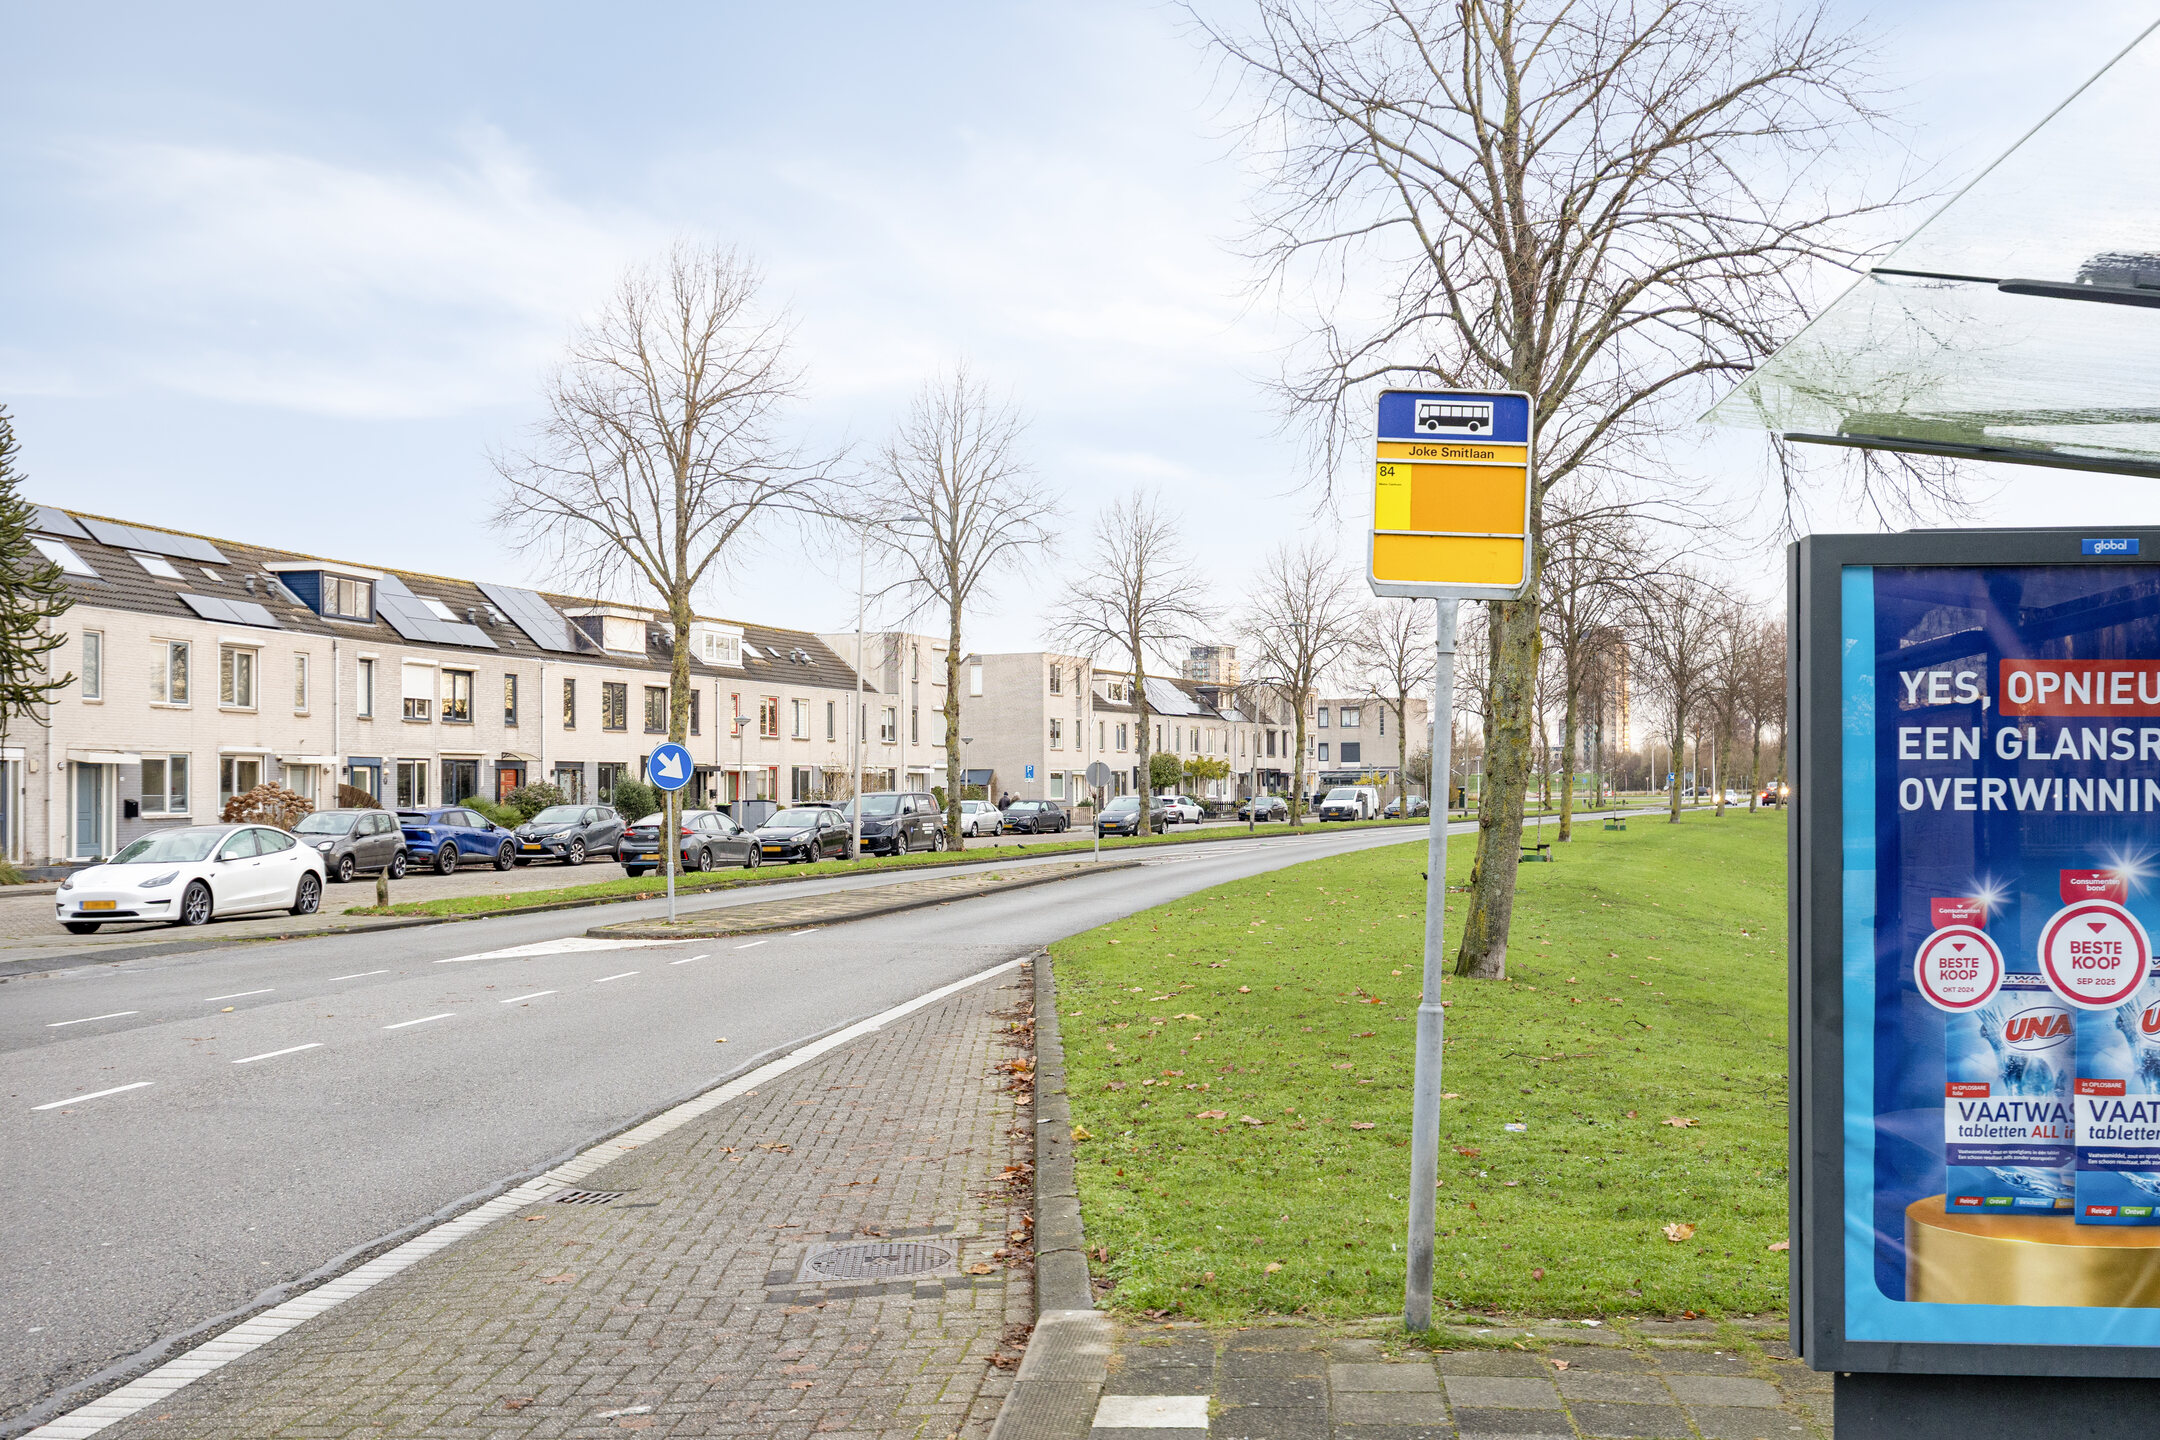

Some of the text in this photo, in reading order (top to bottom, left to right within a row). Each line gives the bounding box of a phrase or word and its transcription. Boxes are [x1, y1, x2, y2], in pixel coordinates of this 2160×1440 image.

[1408, 446, 1494, 458] Joke Smitlaan
[1380, 466, 1395, 476] 84
[2094, 540, 2127, 554] global
[1899, 671, 1991, 711] YES,
[1899, 727, 1980, 760] EEN
[2070, 941, 2122, 954] BESTE
[1939, 958, 1979, 968] BESTE
[2072, 956, 2120, 970] KOOP
[1940, 970, 1978, 980] KOOP
[2005, 1014, 2073, 1042] UNA
[1958, 1124, 2026, 1138] tabletten
[2032, 1126, 2059, 1138] ALL
